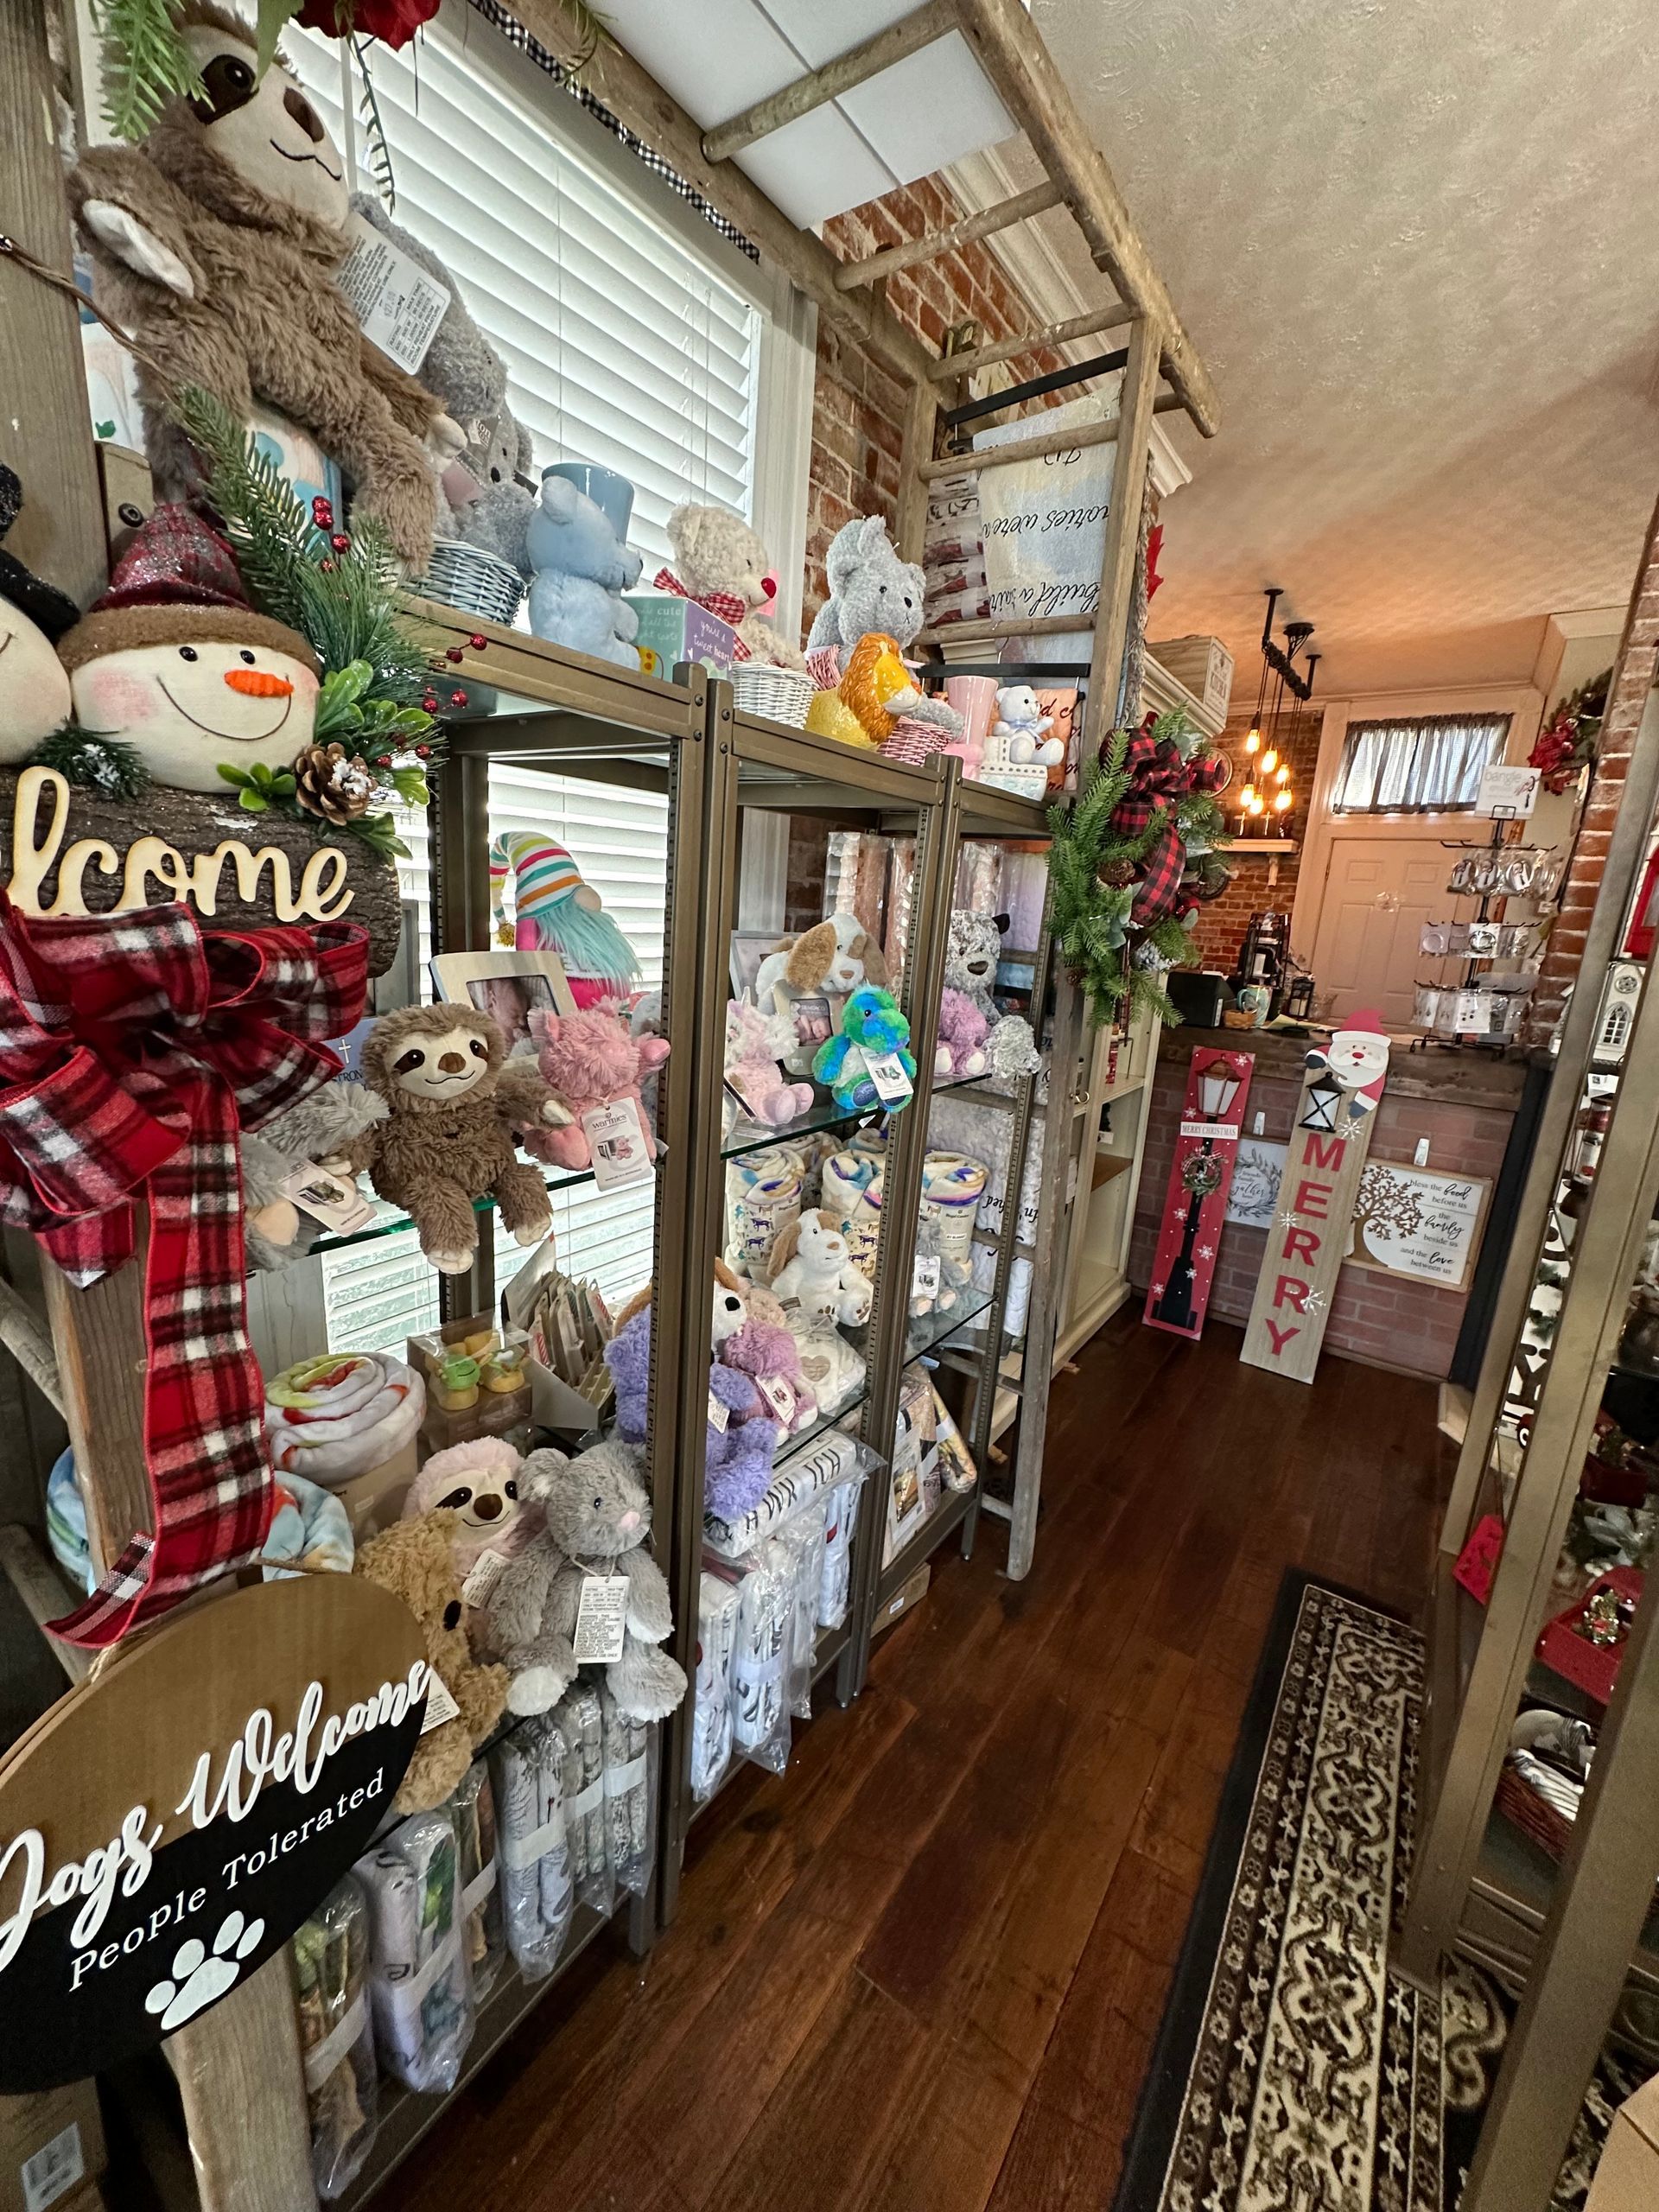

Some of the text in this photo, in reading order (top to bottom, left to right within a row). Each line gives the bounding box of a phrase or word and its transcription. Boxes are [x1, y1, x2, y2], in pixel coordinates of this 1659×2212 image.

[418, 303, 441, 346] TEMPERATURE
[994, 513, 1038, 537] were
[5, 765, 355, 922] lcome
[592, 1114, 628, 1130] warmies
[1182, 1125, 1236, 1136] MERRY CHRISTMAS
[1409, 1179, 1428, 1189] bless
[1443, 1183, 1471, 1200] food
[1432, 1196, 1457, 1206] before
[1424, 1215, 1465, 1240] family
[1265, 1132, 1347, 1357] MERRY
[1423, 1234, 1448, 1245] beside
[1401, 1246, 1414, 1255] and
[1429, 1251, 1455, 1264] love
[1410, 1259, 1452, 1274] between us
[175, 1658, 431, 1831] Welcome
[68, 1767, 385, 1993] People Tolerated
